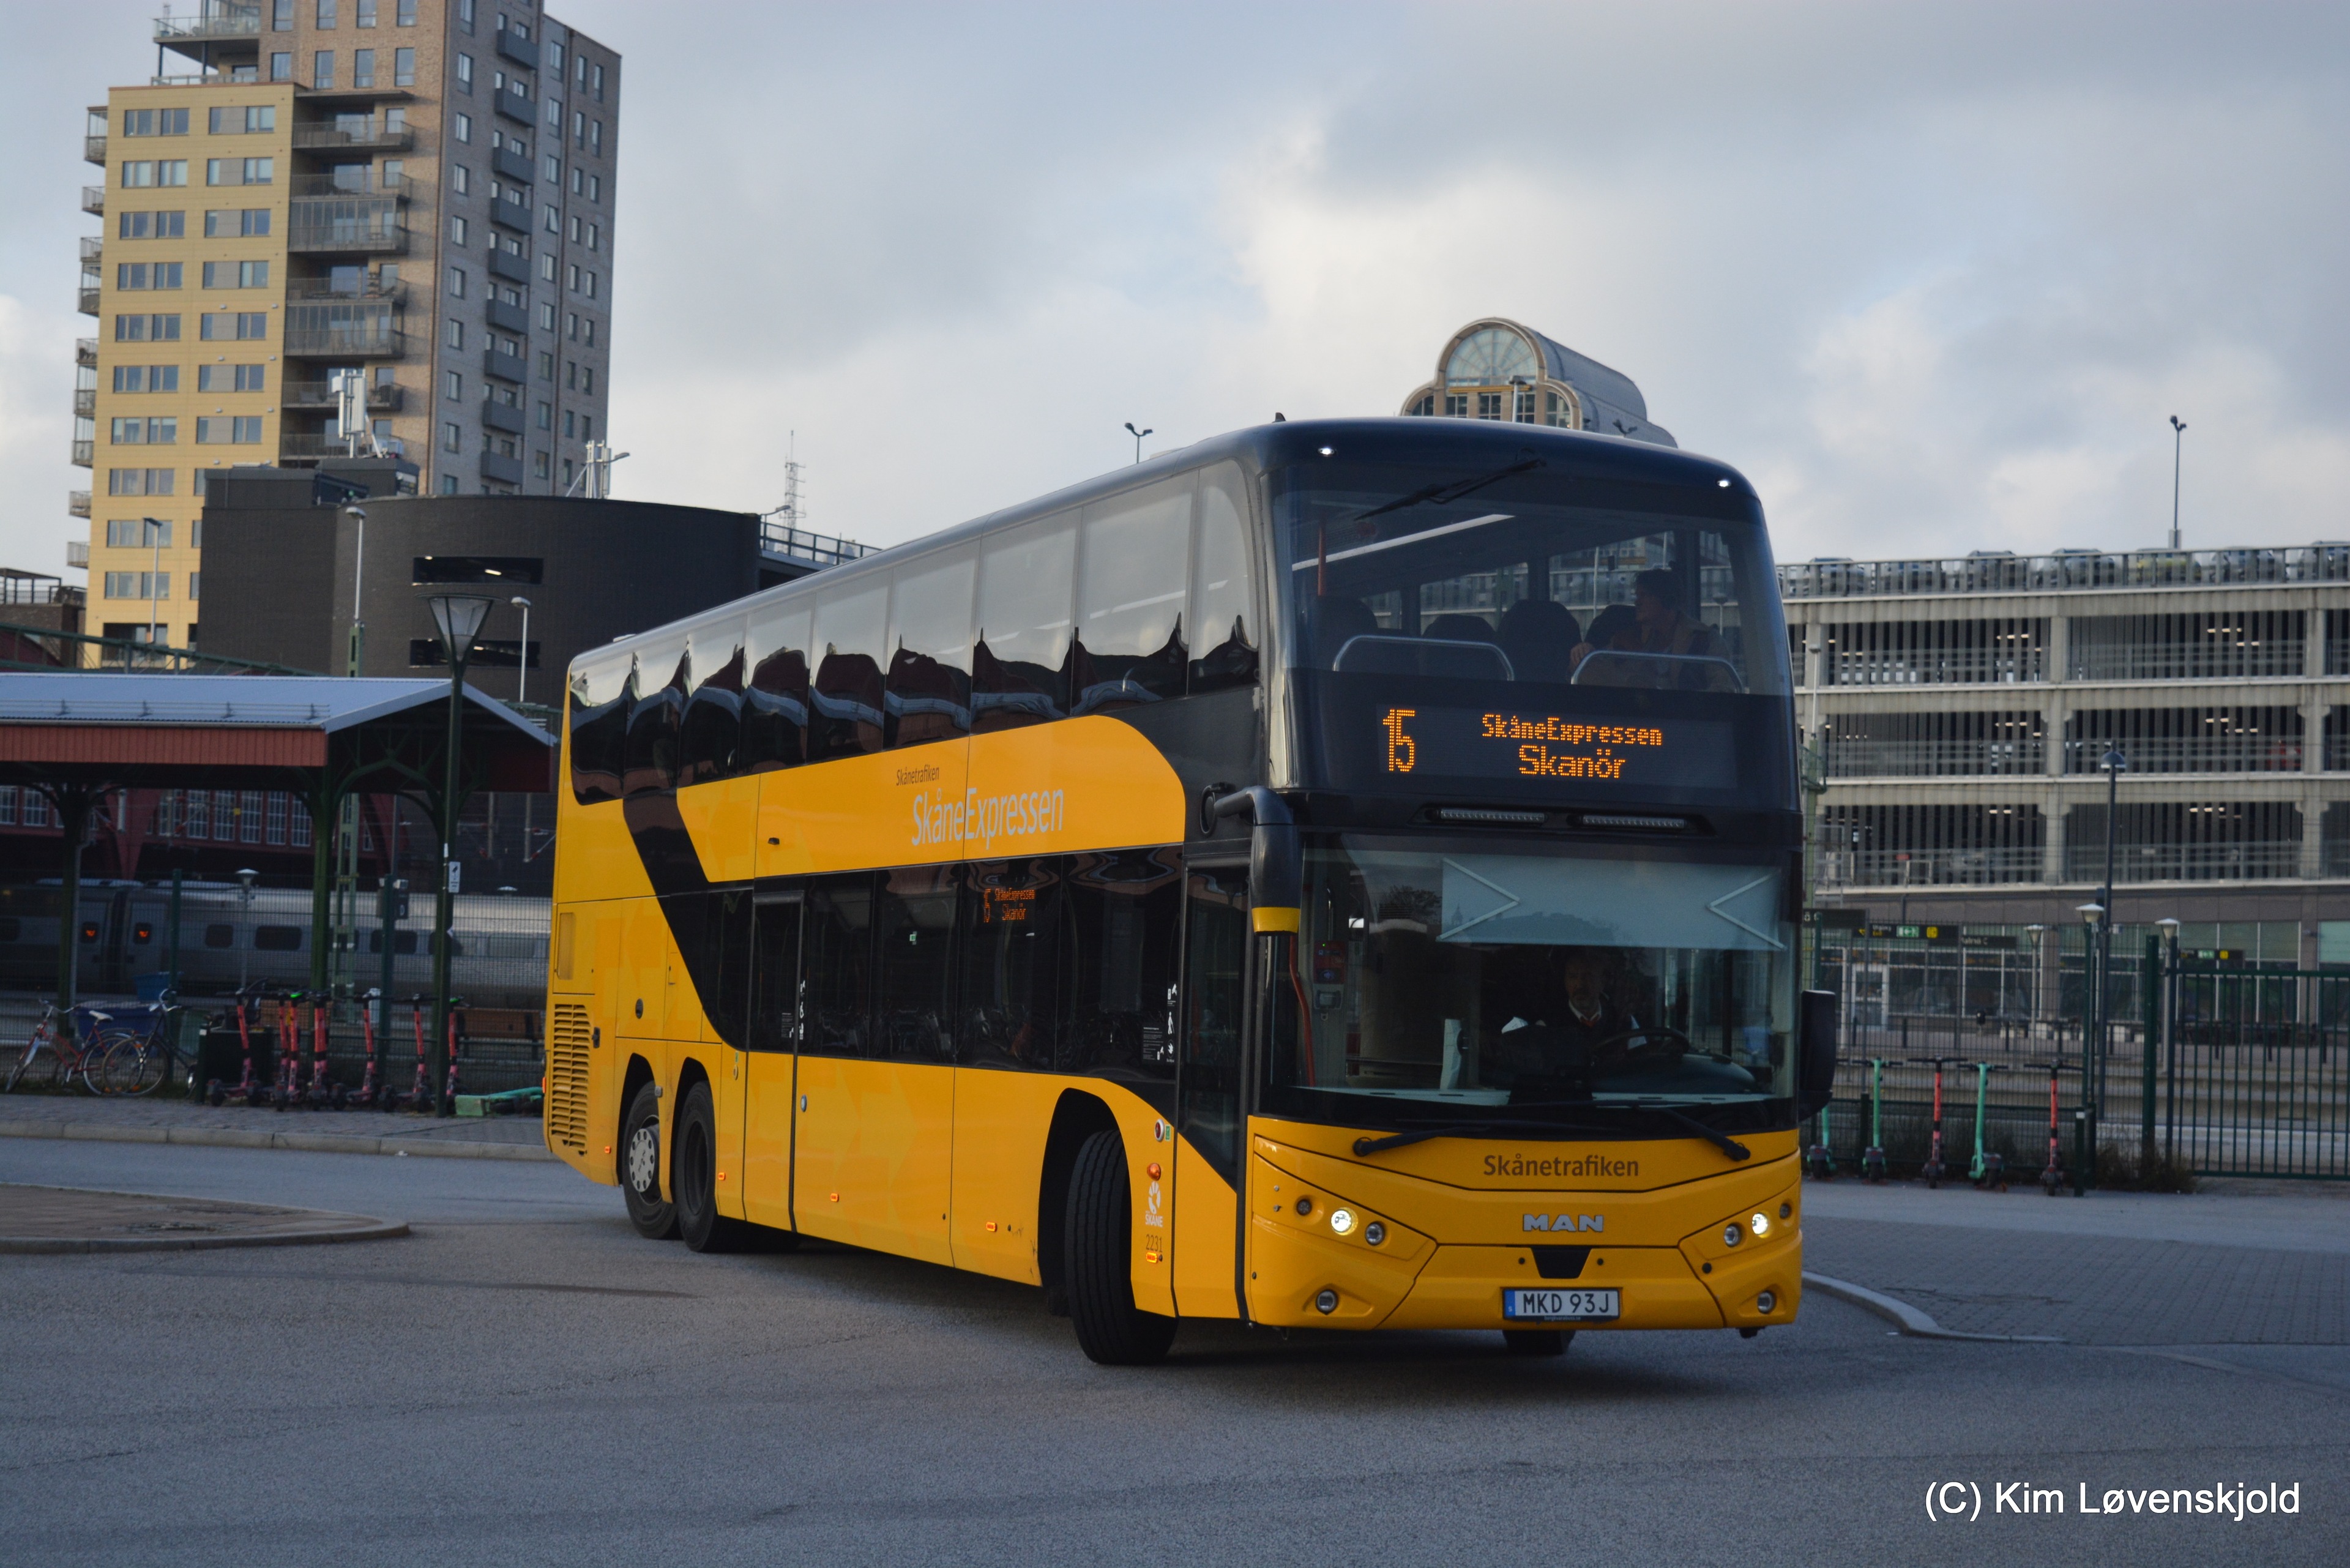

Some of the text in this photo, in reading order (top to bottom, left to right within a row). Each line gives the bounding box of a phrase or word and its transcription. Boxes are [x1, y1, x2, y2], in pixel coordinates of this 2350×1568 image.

[1382, 708, 1416, 772] 15
[1482, 713, 1663, 746] SkåneExpressen
[1518, 745, 1626, 779] Skanör
[896, 764, 940, 786] Skånetrafiken
[911, 787, 1064, 850] SkåneExpressen
[1483, 1153, 1639, 1177] Skånetrafiken
[1523, 1214, 1604, 1233] MAN
[1146, 1233, 1163, 1253] 2231
[1523, 1293, 1609, 1313] MKD 93J
